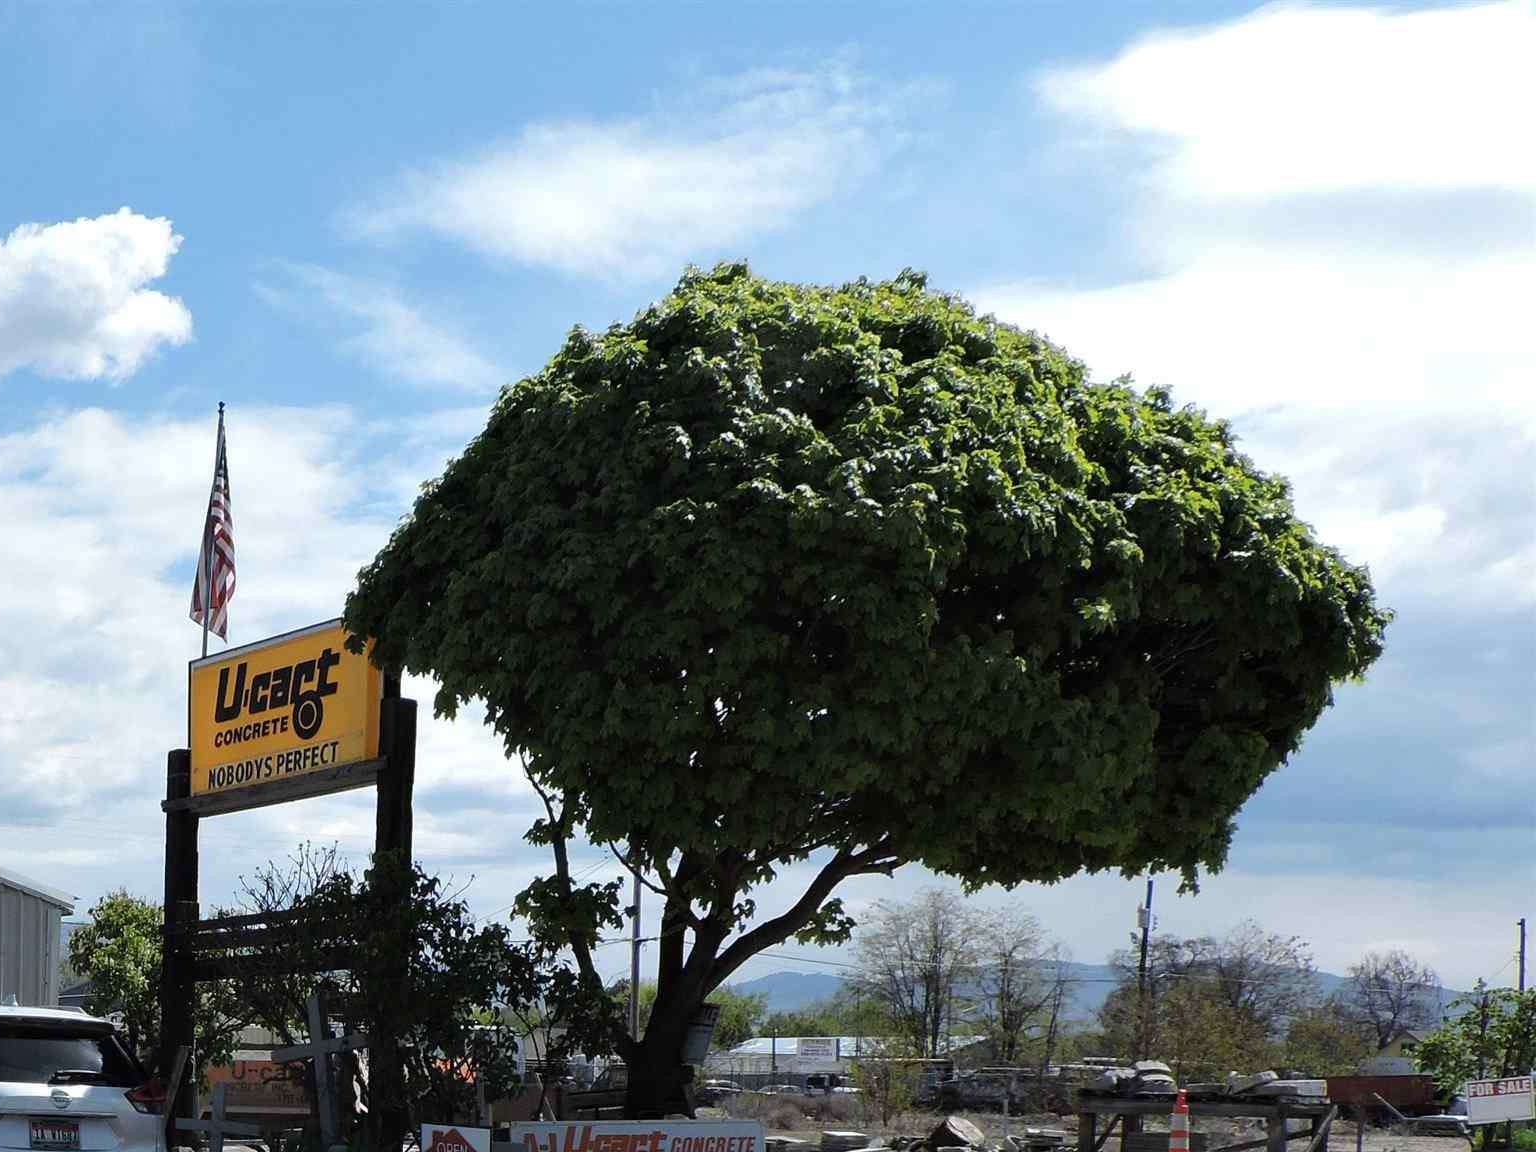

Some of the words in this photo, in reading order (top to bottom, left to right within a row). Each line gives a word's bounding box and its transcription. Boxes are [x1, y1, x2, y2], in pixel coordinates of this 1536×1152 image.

[214, 715, 290, 748] CONCRETE
[208, 756, 273, 790] NOBODYS
[276, 741, 339, 776] PERFECT
[1468, 1082, 1495, 1096] FOR
[1497, 1079, 1532, 1094] SALE
